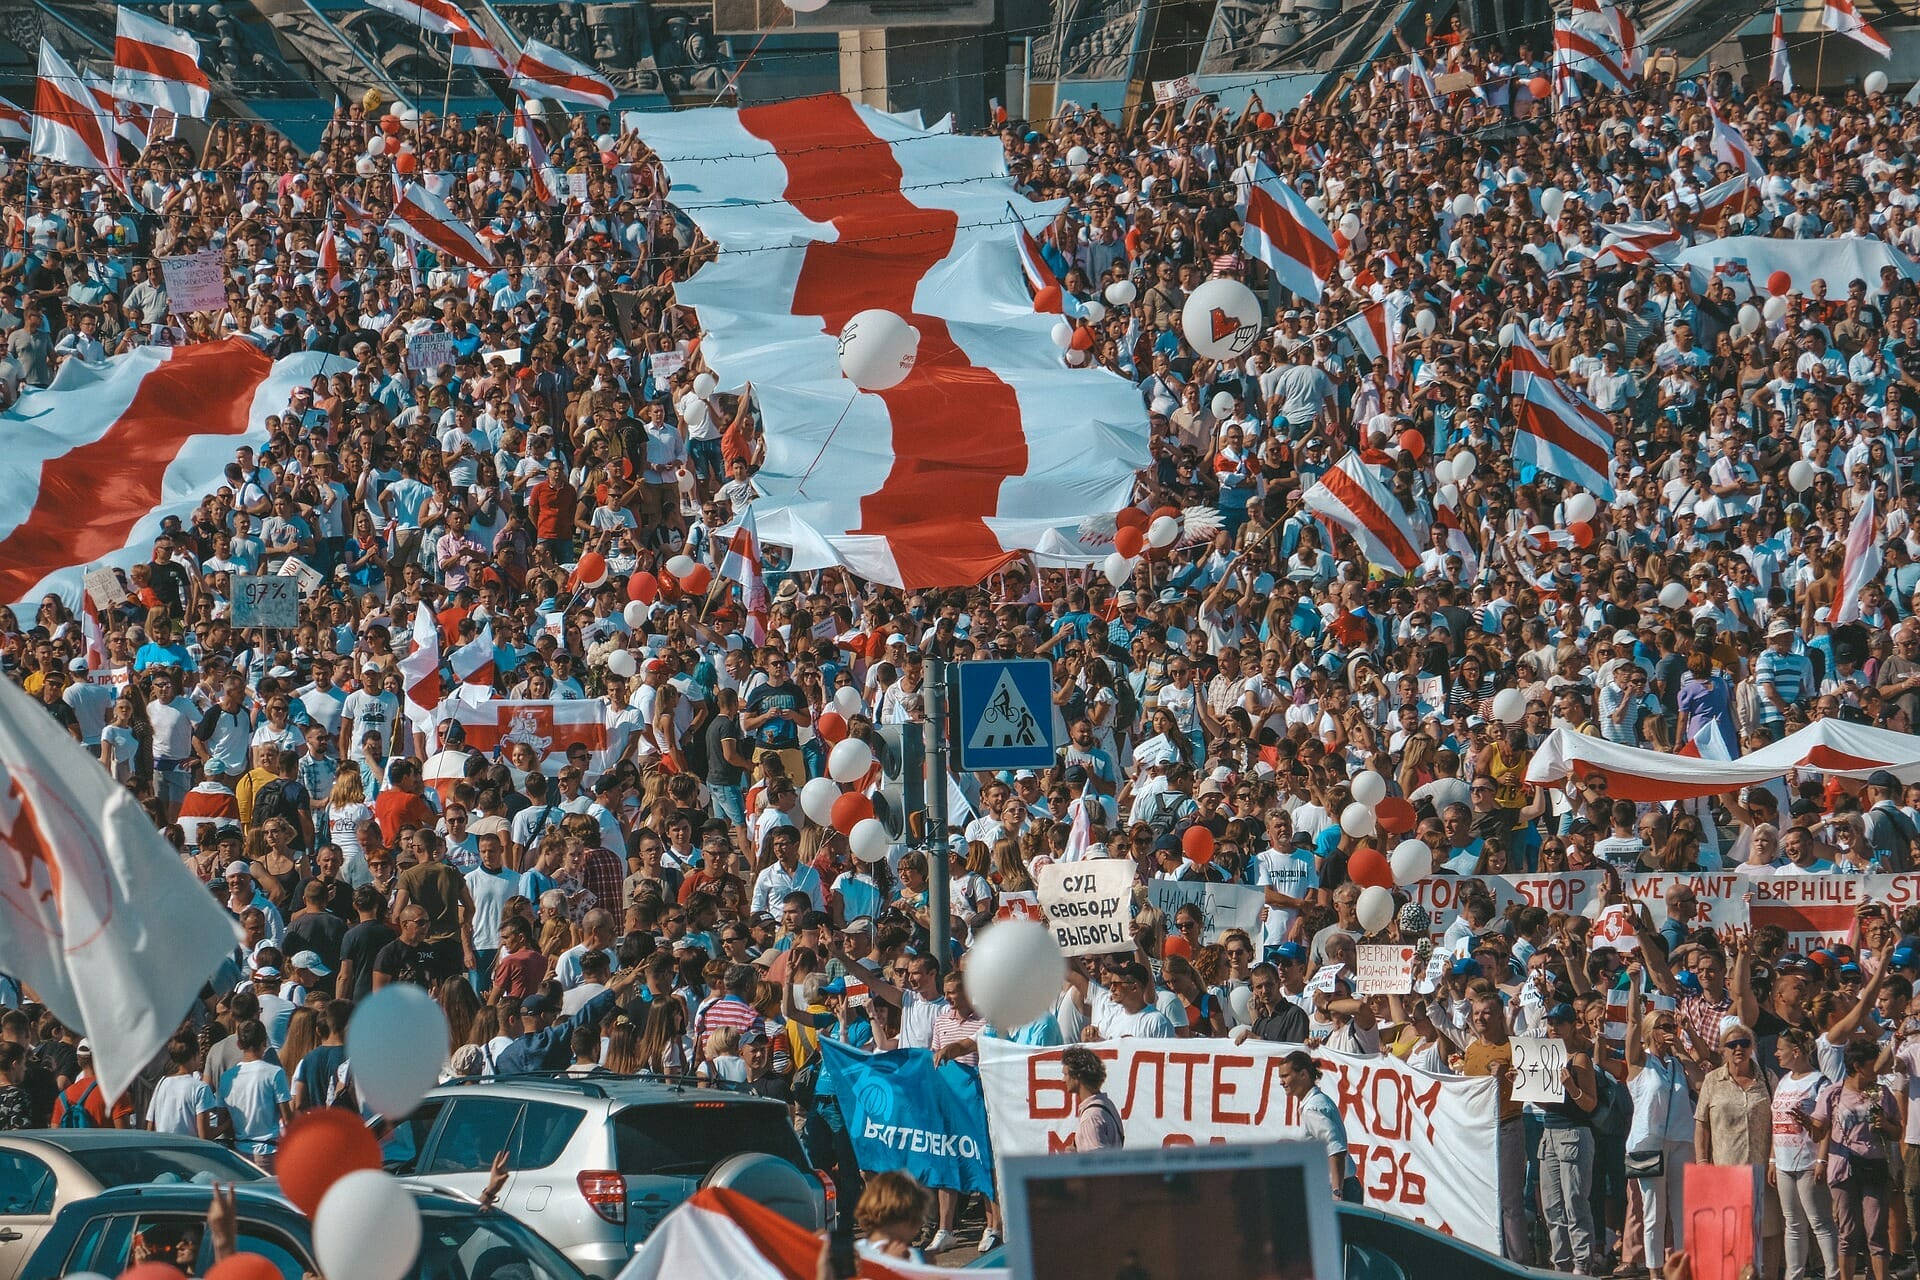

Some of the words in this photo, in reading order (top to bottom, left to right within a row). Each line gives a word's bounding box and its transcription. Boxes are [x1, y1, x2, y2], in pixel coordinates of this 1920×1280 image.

[246, 583, 286, 605] 97%
[1063, 874, 1097, 893] СУД
[1515, 879, 1586, 910] STOP
[1631, 877, 1664, 898] WE
[1757, 877, 1857, 904] ВЯРНІЦЕ
[1050, 897, 1120, 918] СВОБОДУ
[1057, 922, 1124, 947] ВЫБОРЫ
[1359, 946, 1400, 962] ВЕРЫМ
[1027, 1049, 1441, 1145] БЛТЕЛКОМ
